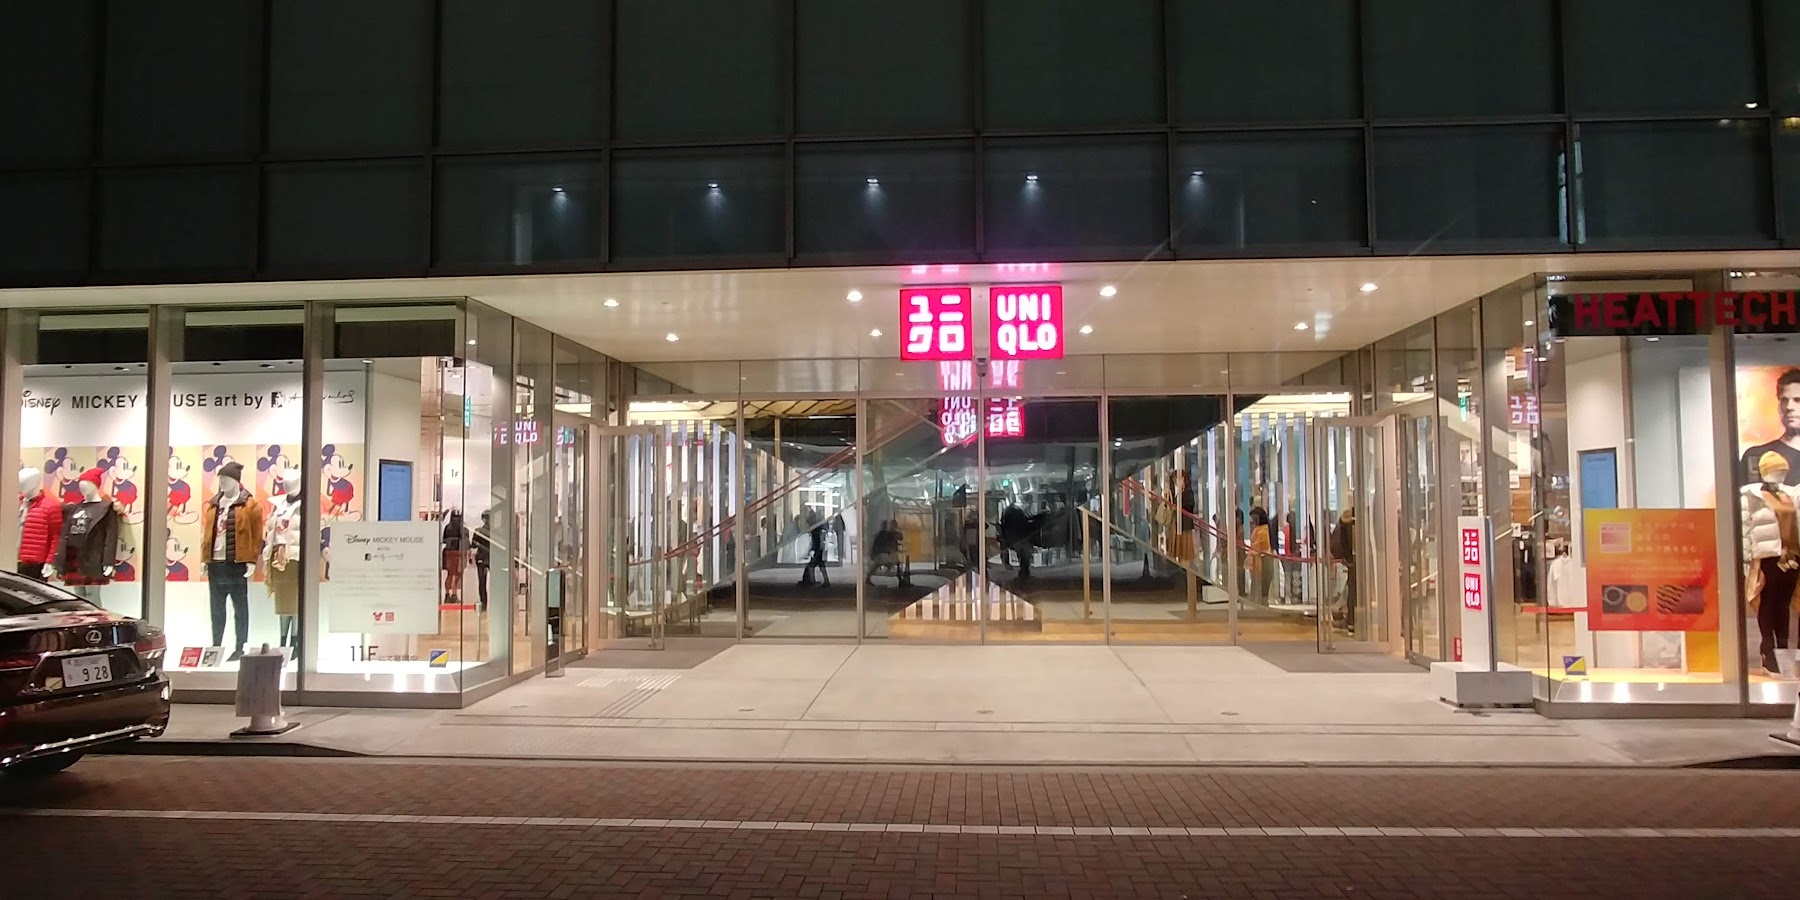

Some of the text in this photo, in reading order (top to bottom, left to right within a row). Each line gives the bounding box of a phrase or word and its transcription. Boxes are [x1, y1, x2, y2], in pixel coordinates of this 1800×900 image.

[908, 295, 964, 322] ユニ
[997, 294, 1052, 321] UNI
[1573, 290, 1796, 328] HEATTECH
[907, 325, 965, 353] クロ
[997, 323, 1057, 355] QLO
[71, 394, 138, 409] MICKEY
[214, 396, 237, 407] art
[244, 393, 263, 409] by
[515, 421, 537, 432] UNI
[82, 668, 90, 681] 9
[94, 665, 109, 680] 28
